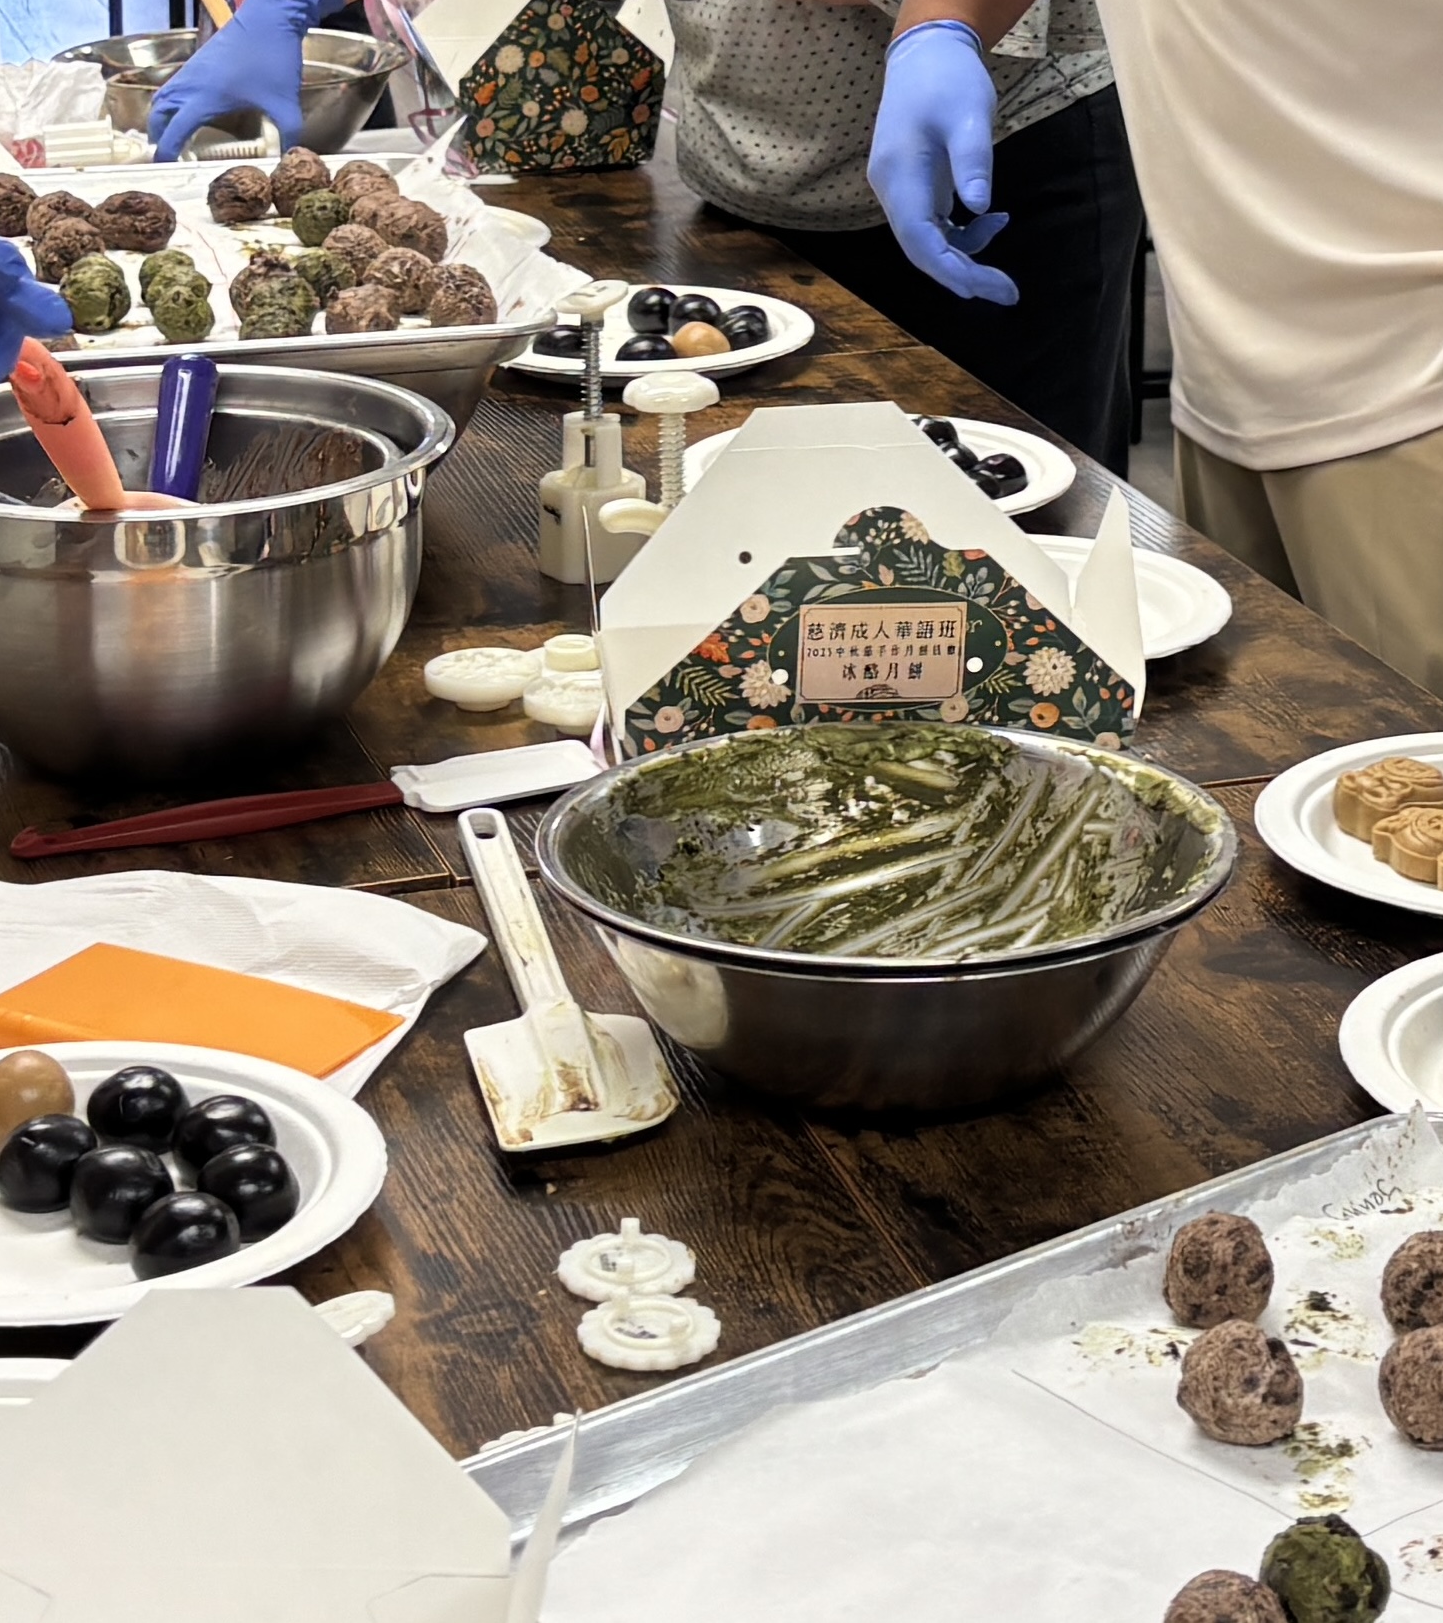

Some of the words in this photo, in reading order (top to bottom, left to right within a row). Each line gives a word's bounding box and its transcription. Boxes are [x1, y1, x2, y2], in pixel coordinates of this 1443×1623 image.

[807, 619, 958, 642] 慈濟成人華語班
